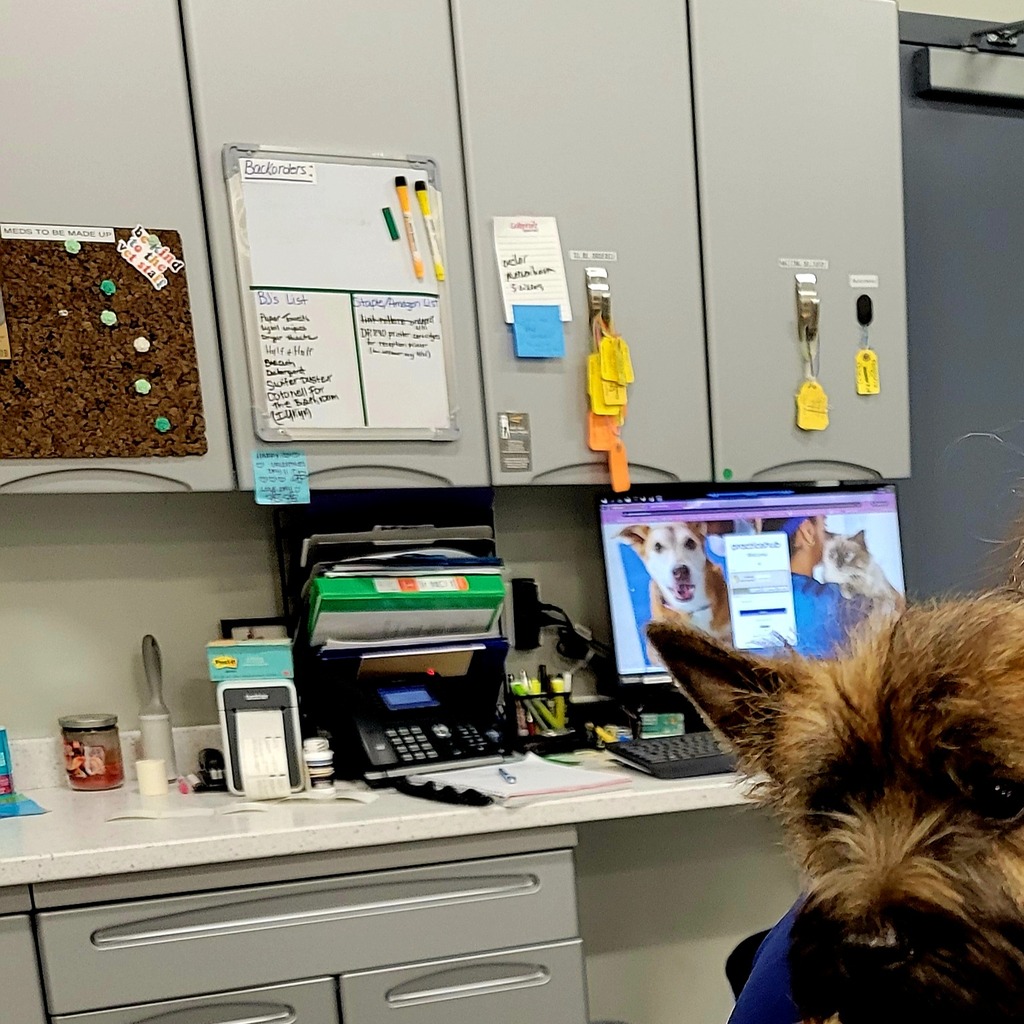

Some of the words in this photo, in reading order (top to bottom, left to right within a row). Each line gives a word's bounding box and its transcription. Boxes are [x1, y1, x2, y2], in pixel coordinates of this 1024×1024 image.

[3, 227, 33, 235] MEDS
[36, 228, 50, 236] TO
[144, 252, 166, 271] the
